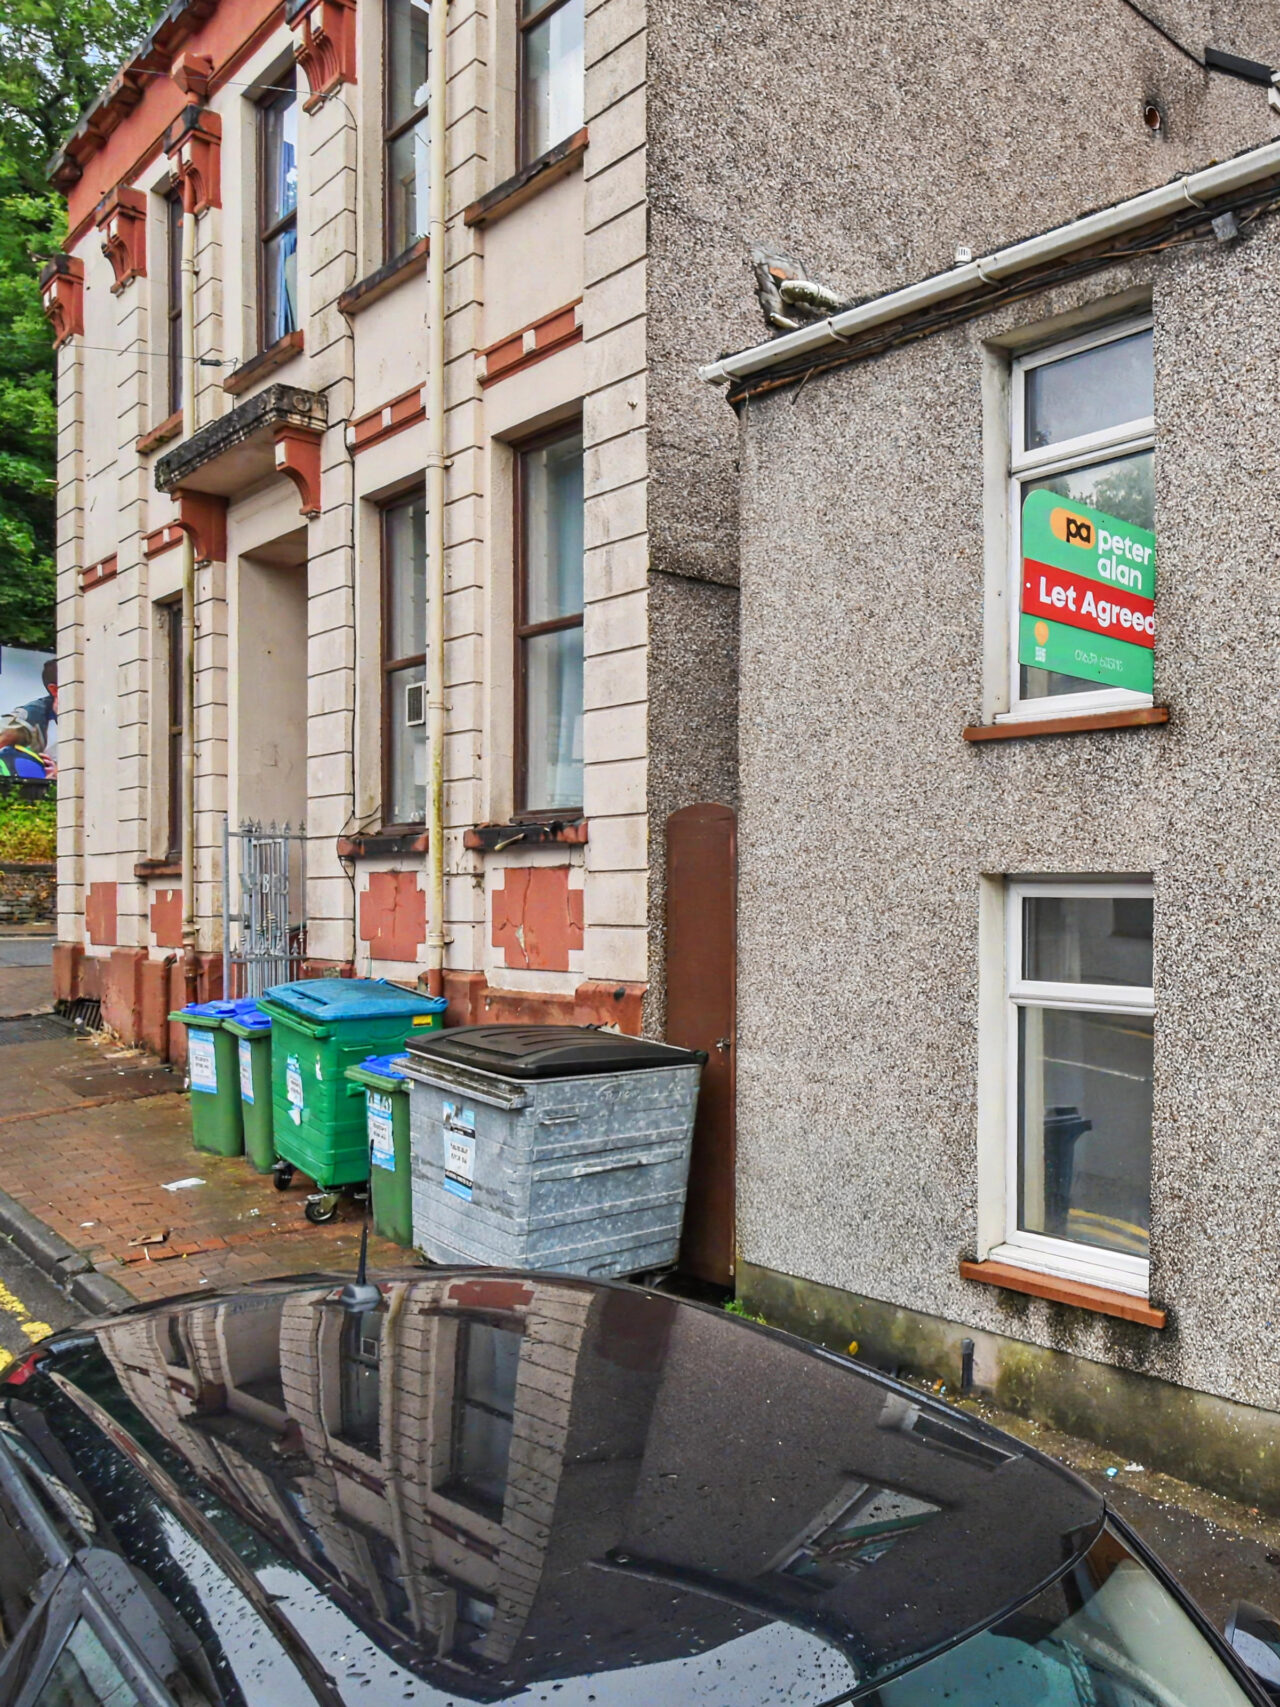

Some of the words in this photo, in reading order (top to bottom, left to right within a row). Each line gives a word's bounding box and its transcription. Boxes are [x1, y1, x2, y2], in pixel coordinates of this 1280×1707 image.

[1066, 517, 1091, 543] pa
[1097, 529, 1152, 566] peter
[1097, 555, 1142, 590] alan
[1039, 576, 1077, 612] Let
